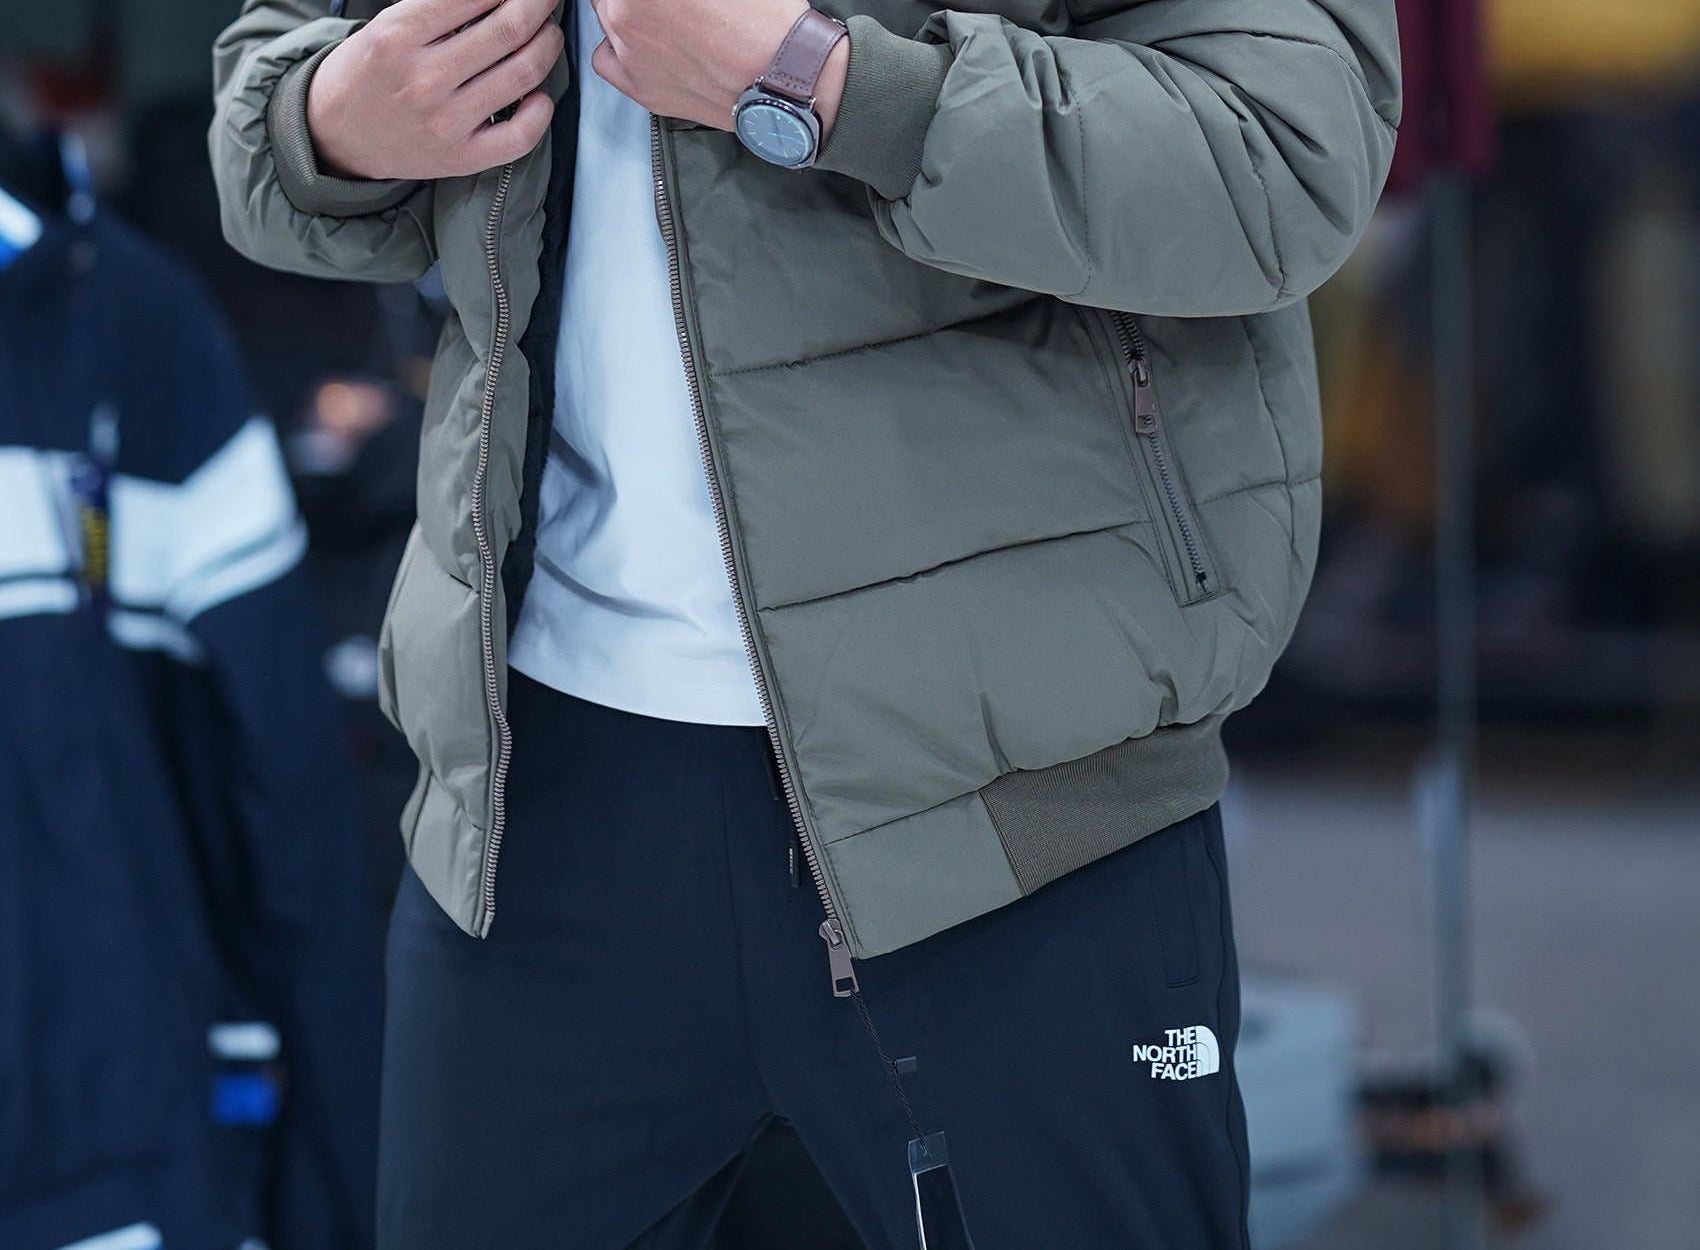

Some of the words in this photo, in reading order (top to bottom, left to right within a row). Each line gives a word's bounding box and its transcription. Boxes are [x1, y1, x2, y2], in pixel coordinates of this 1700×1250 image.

[1164, 1026, 1196, 1047] THE
[1132, 1043, 1197, 1064] NORTH
[1150, 1061, 1197, 1081] FACE
